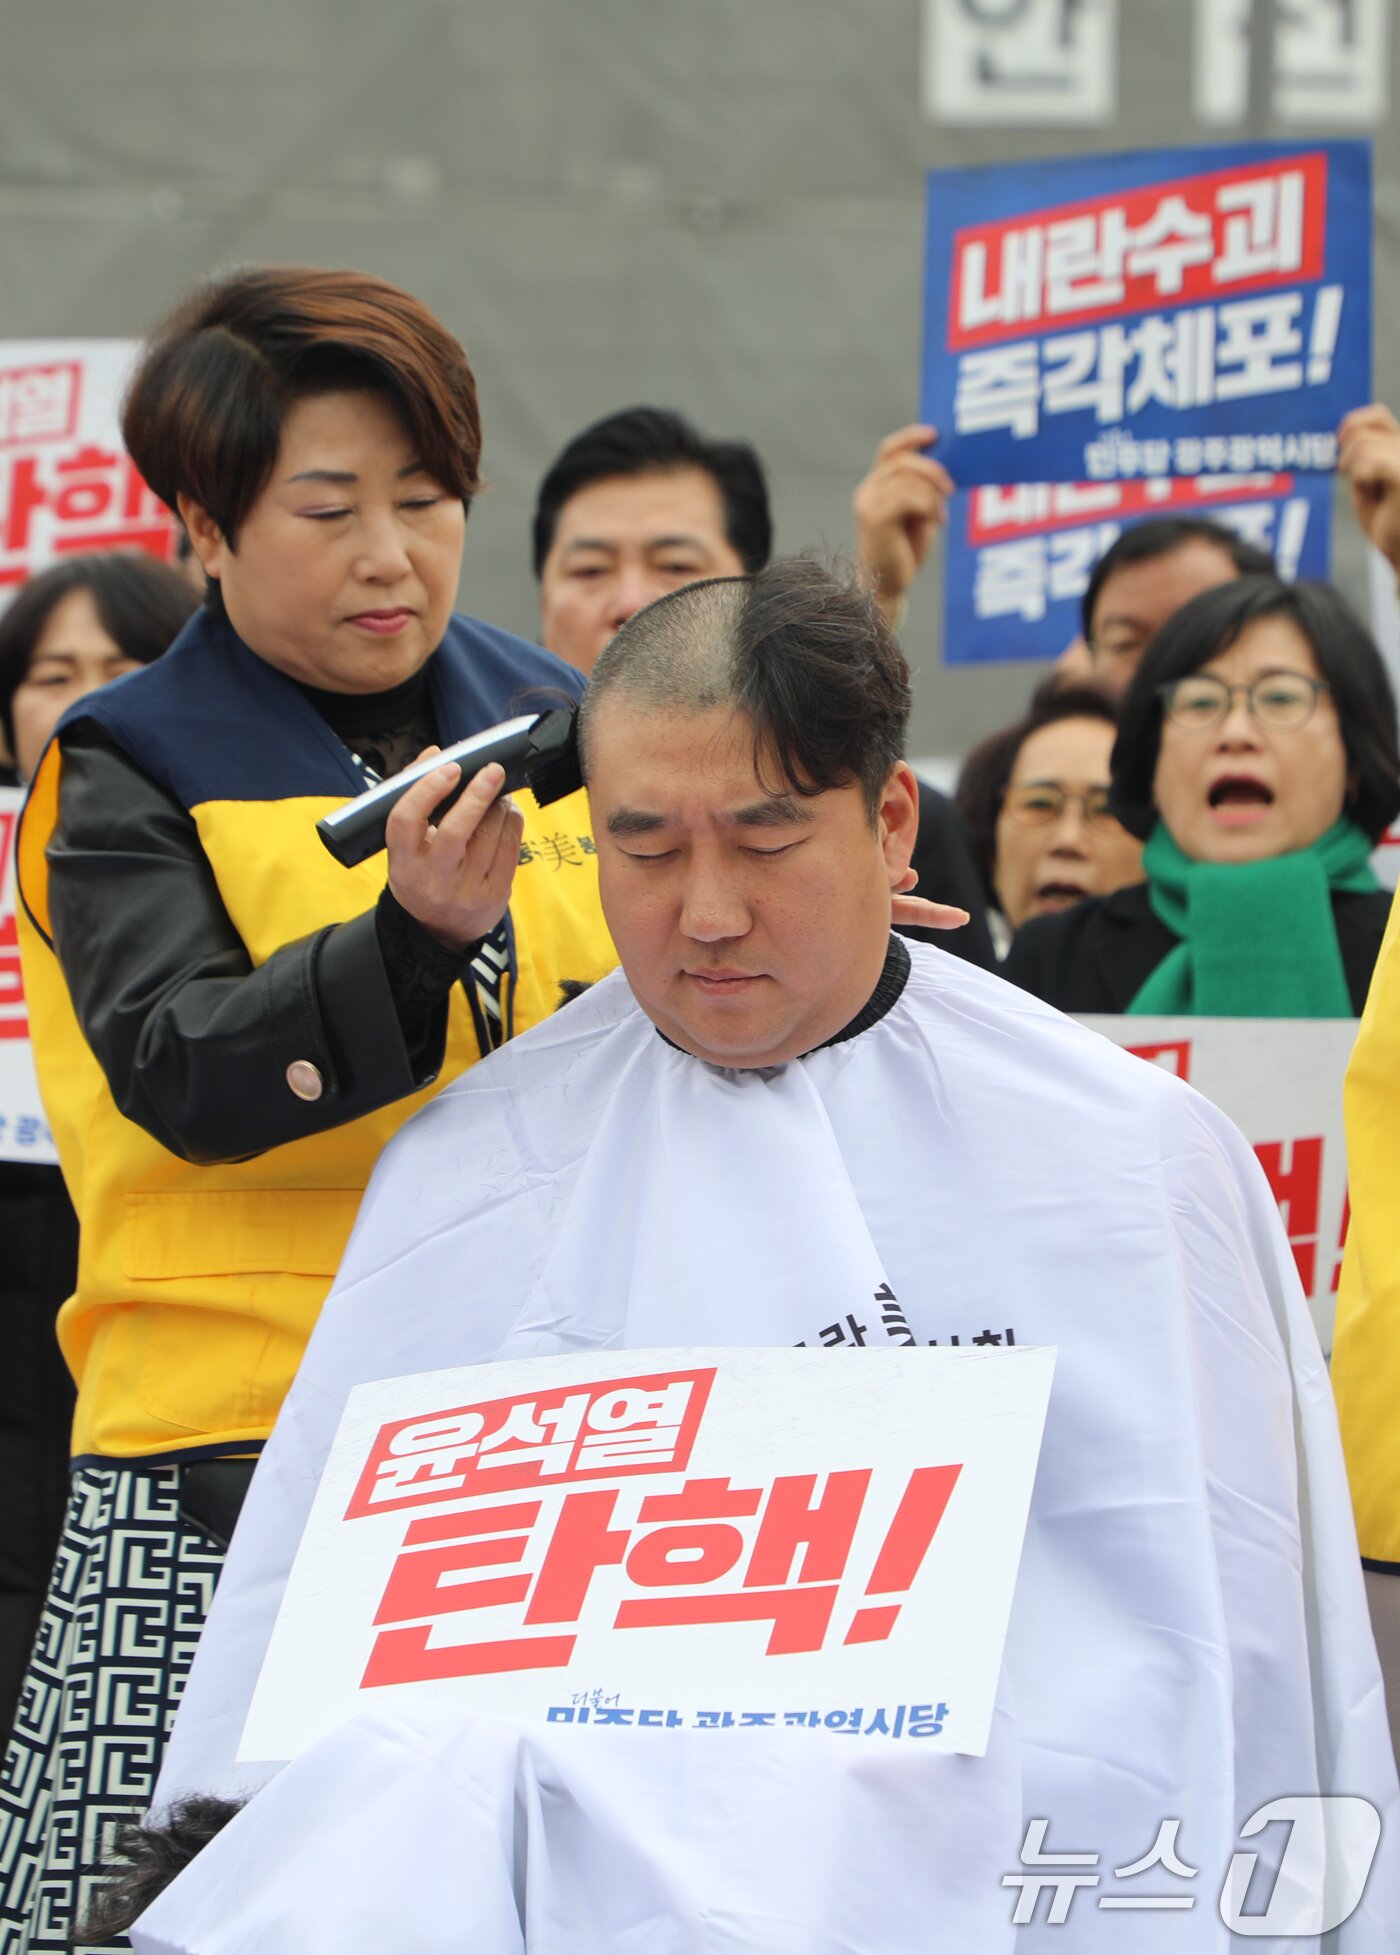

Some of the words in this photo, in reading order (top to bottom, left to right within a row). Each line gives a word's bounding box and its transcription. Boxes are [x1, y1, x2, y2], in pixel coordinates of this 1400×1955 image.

[957, 170, 1305, 331] 내란수괴
[954, 285, 1344, 439] 즉각체포!
[368, 1381, 695, 1505] 윤석열
[359, 1464, 964, 1690] 탄핵!
[571, 1688, 620, 1709] 더불어
